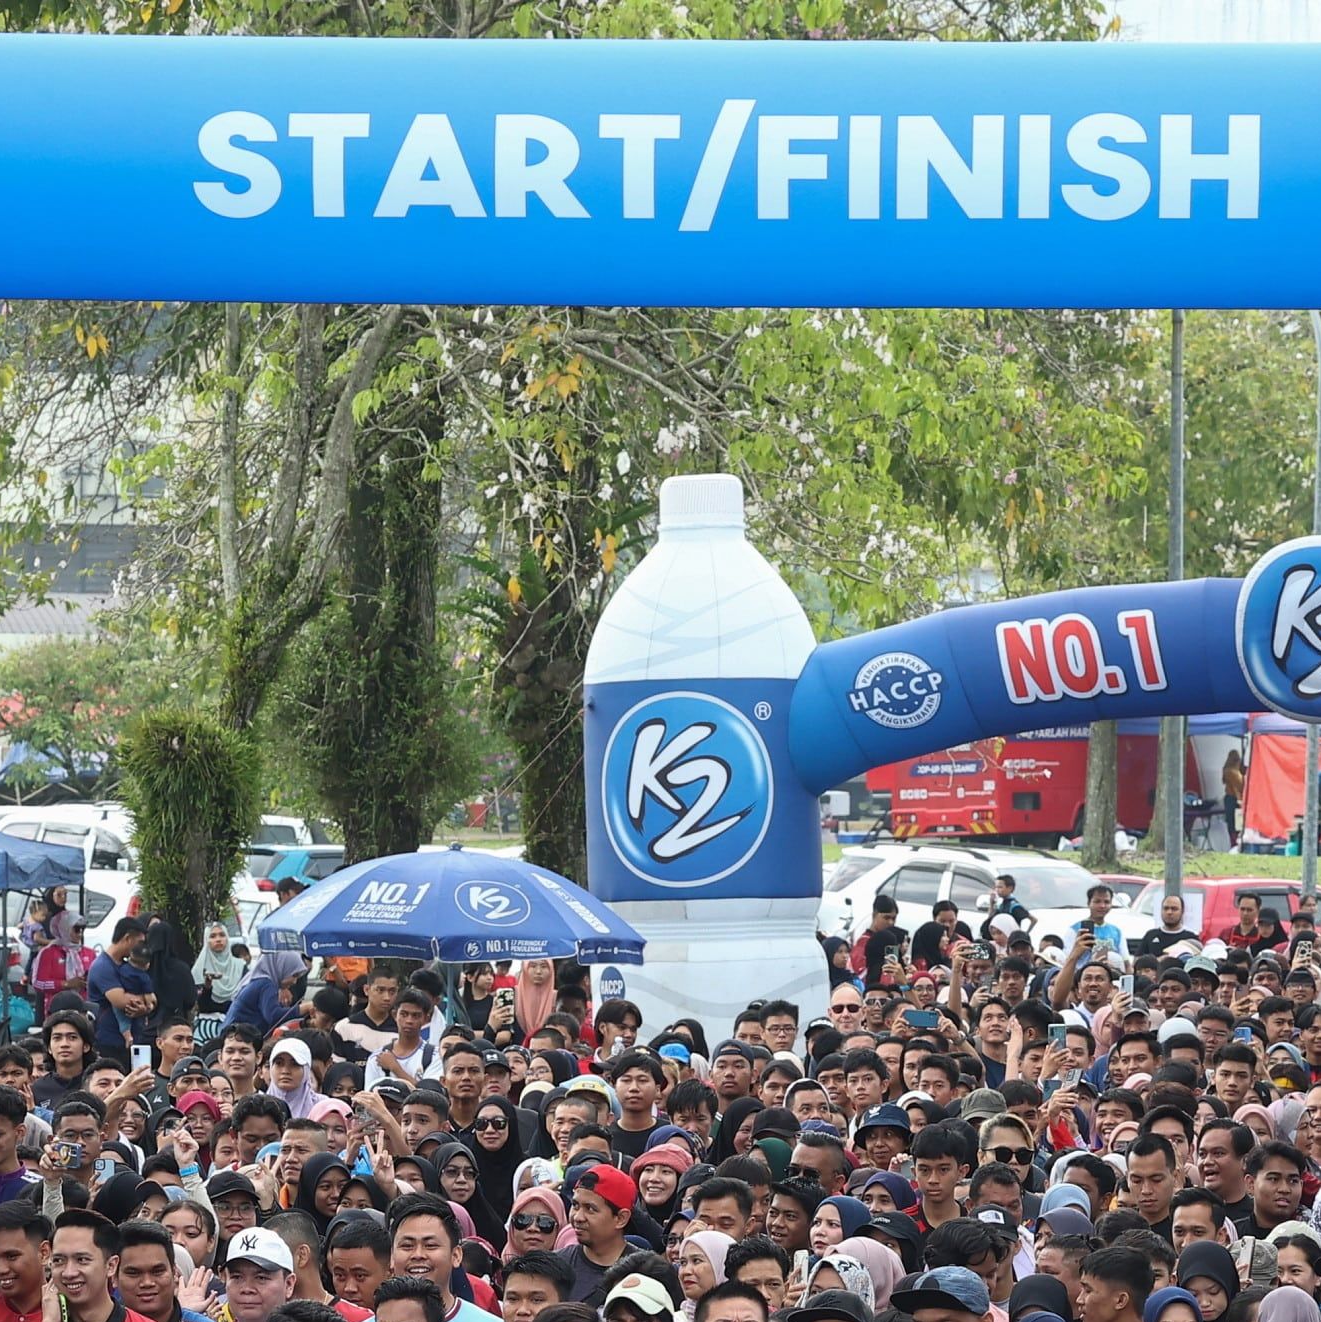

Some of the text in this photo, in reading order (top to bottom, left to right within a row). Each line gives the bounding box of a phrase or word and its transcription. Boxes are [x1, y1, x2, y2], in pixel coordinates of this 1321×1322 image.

[192, 98, 1263, 232] START/FINISH
[849, 672, 943, 711] HACCP
[996, 609, 1170, 706] NO.1
[627, 717, 753, 863] K2
[468, 886, 521, 920] K2
[601, 980, 624, 996] HACCP
